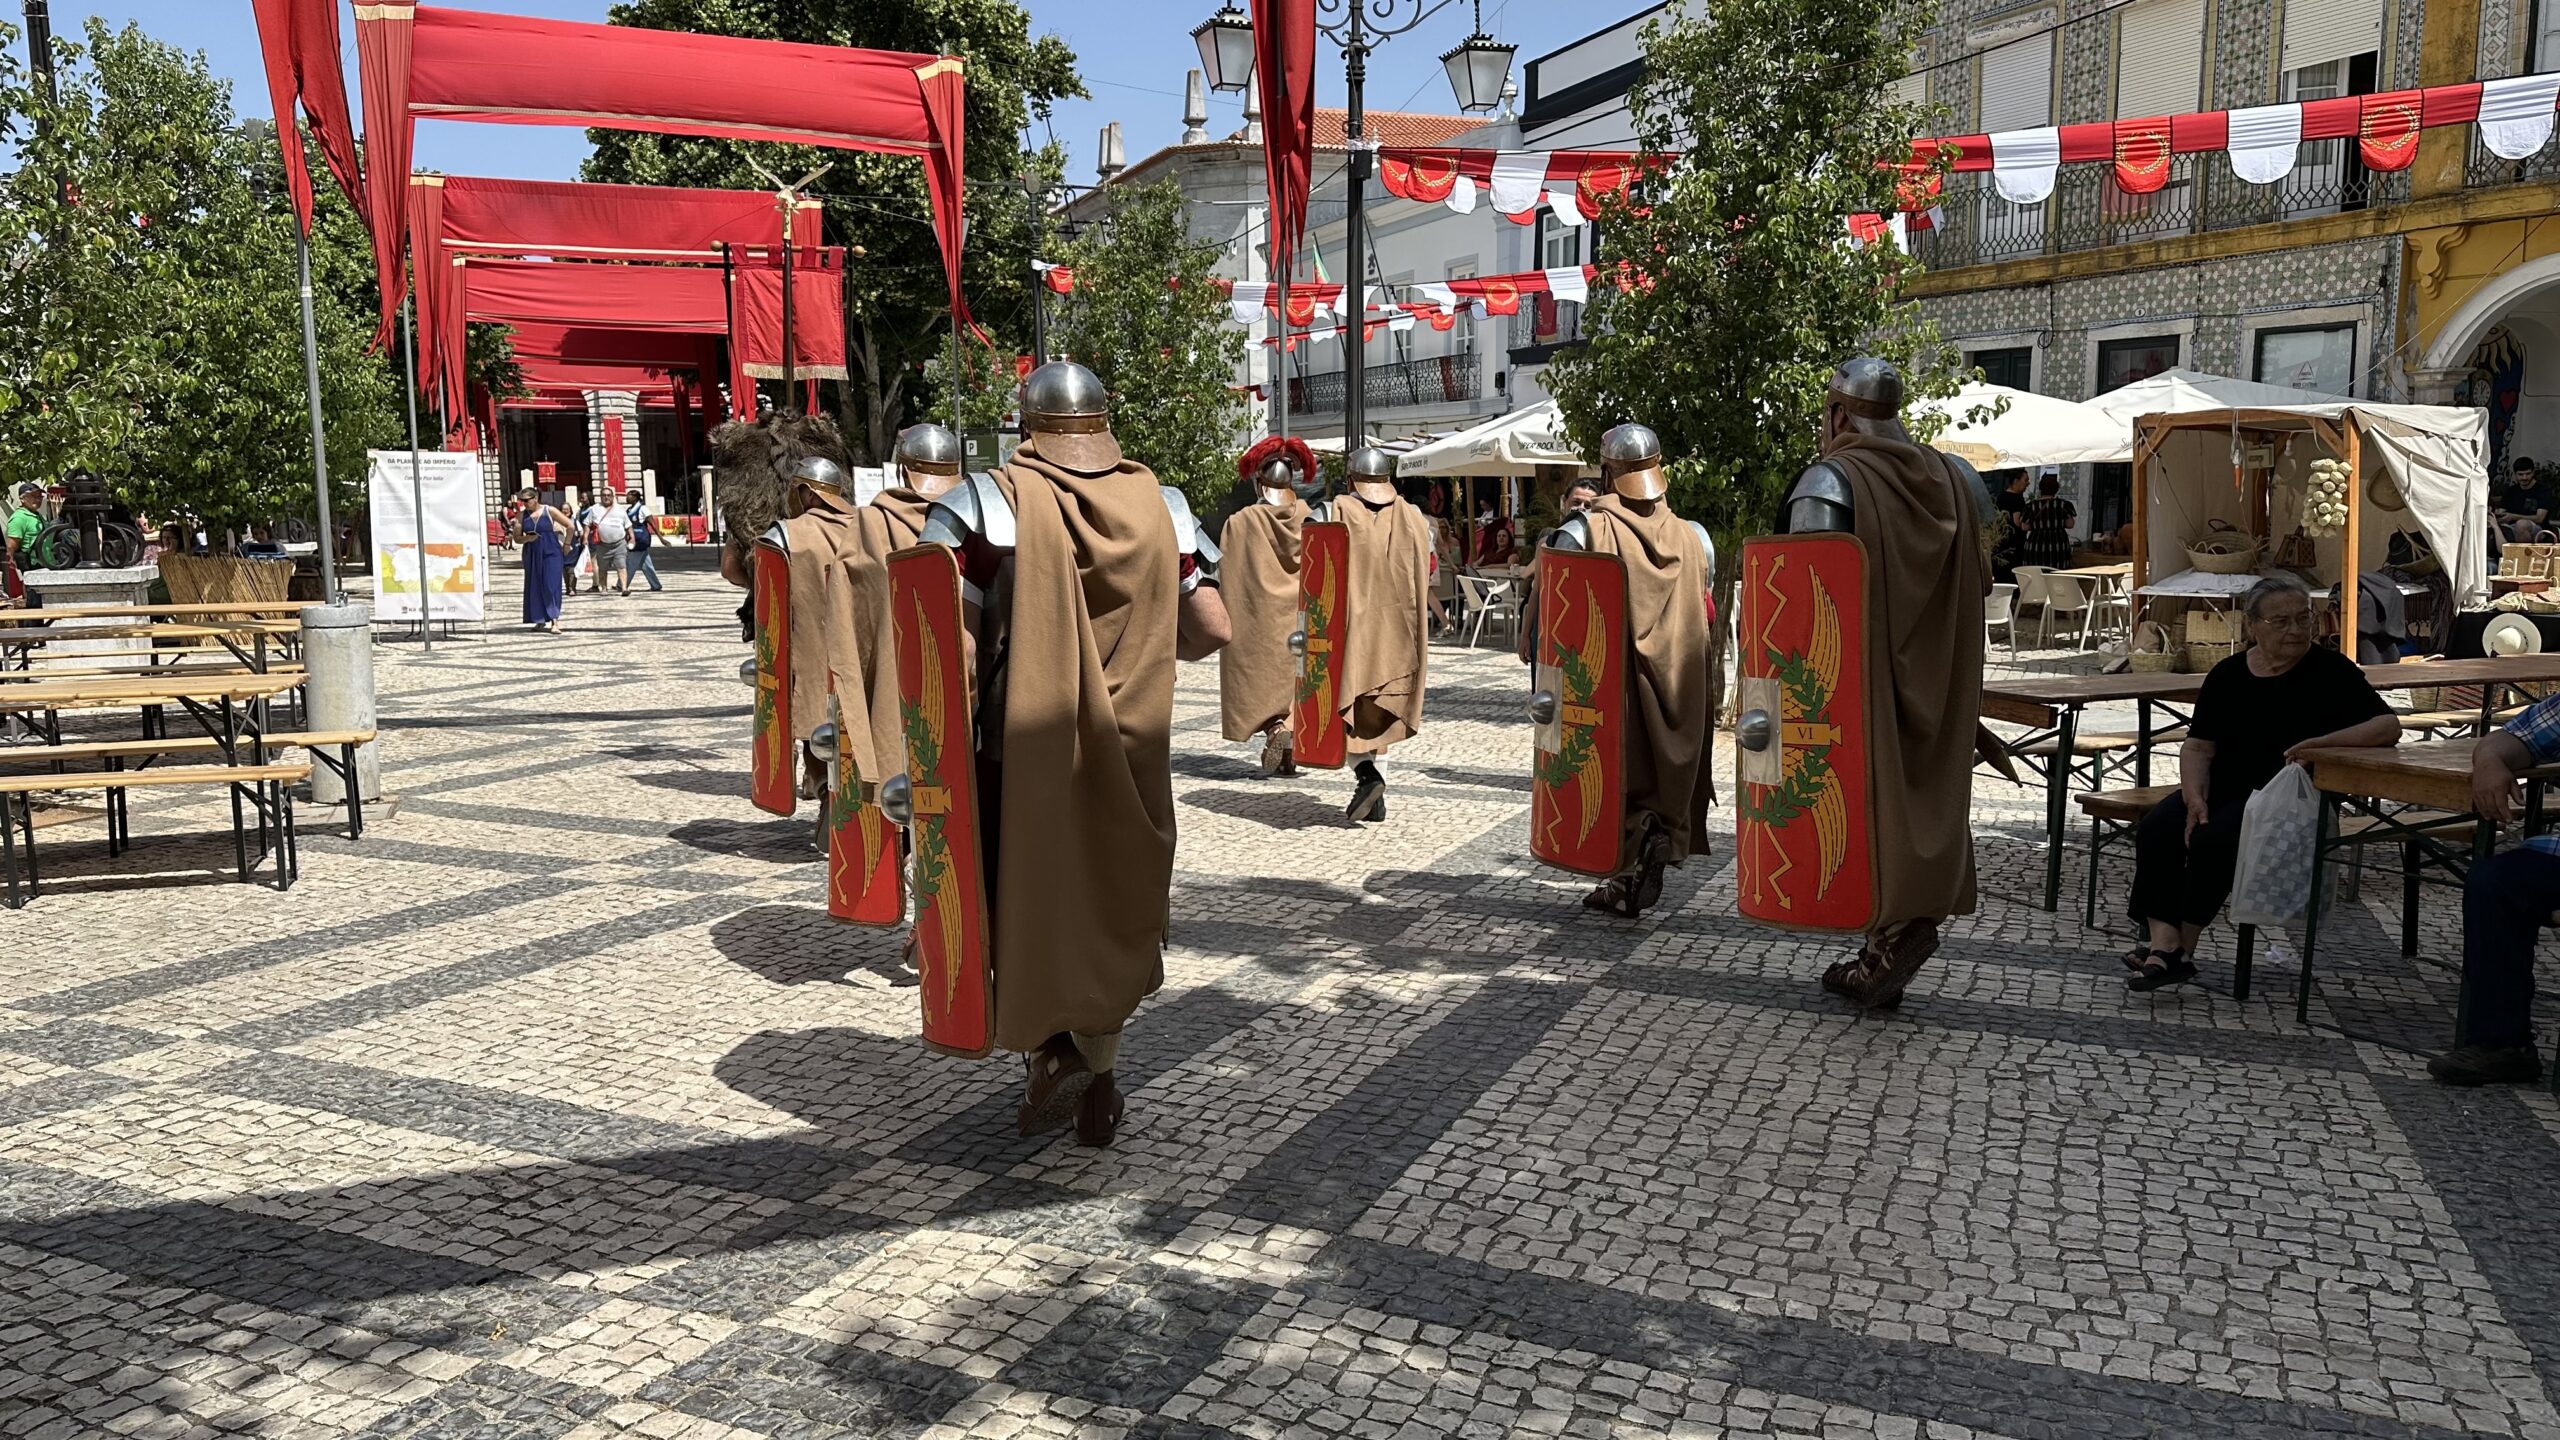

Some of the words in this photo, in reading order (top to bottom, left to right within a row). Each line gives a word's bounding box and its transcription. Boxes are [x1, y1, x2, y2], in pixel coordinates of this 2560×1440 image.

[1536, 441, 1554, 450] BOCK
[1572, 708, 1584, 721] VI
[1797, 726, 1815, 740] VI
[920, 791, 933, 808] VI
